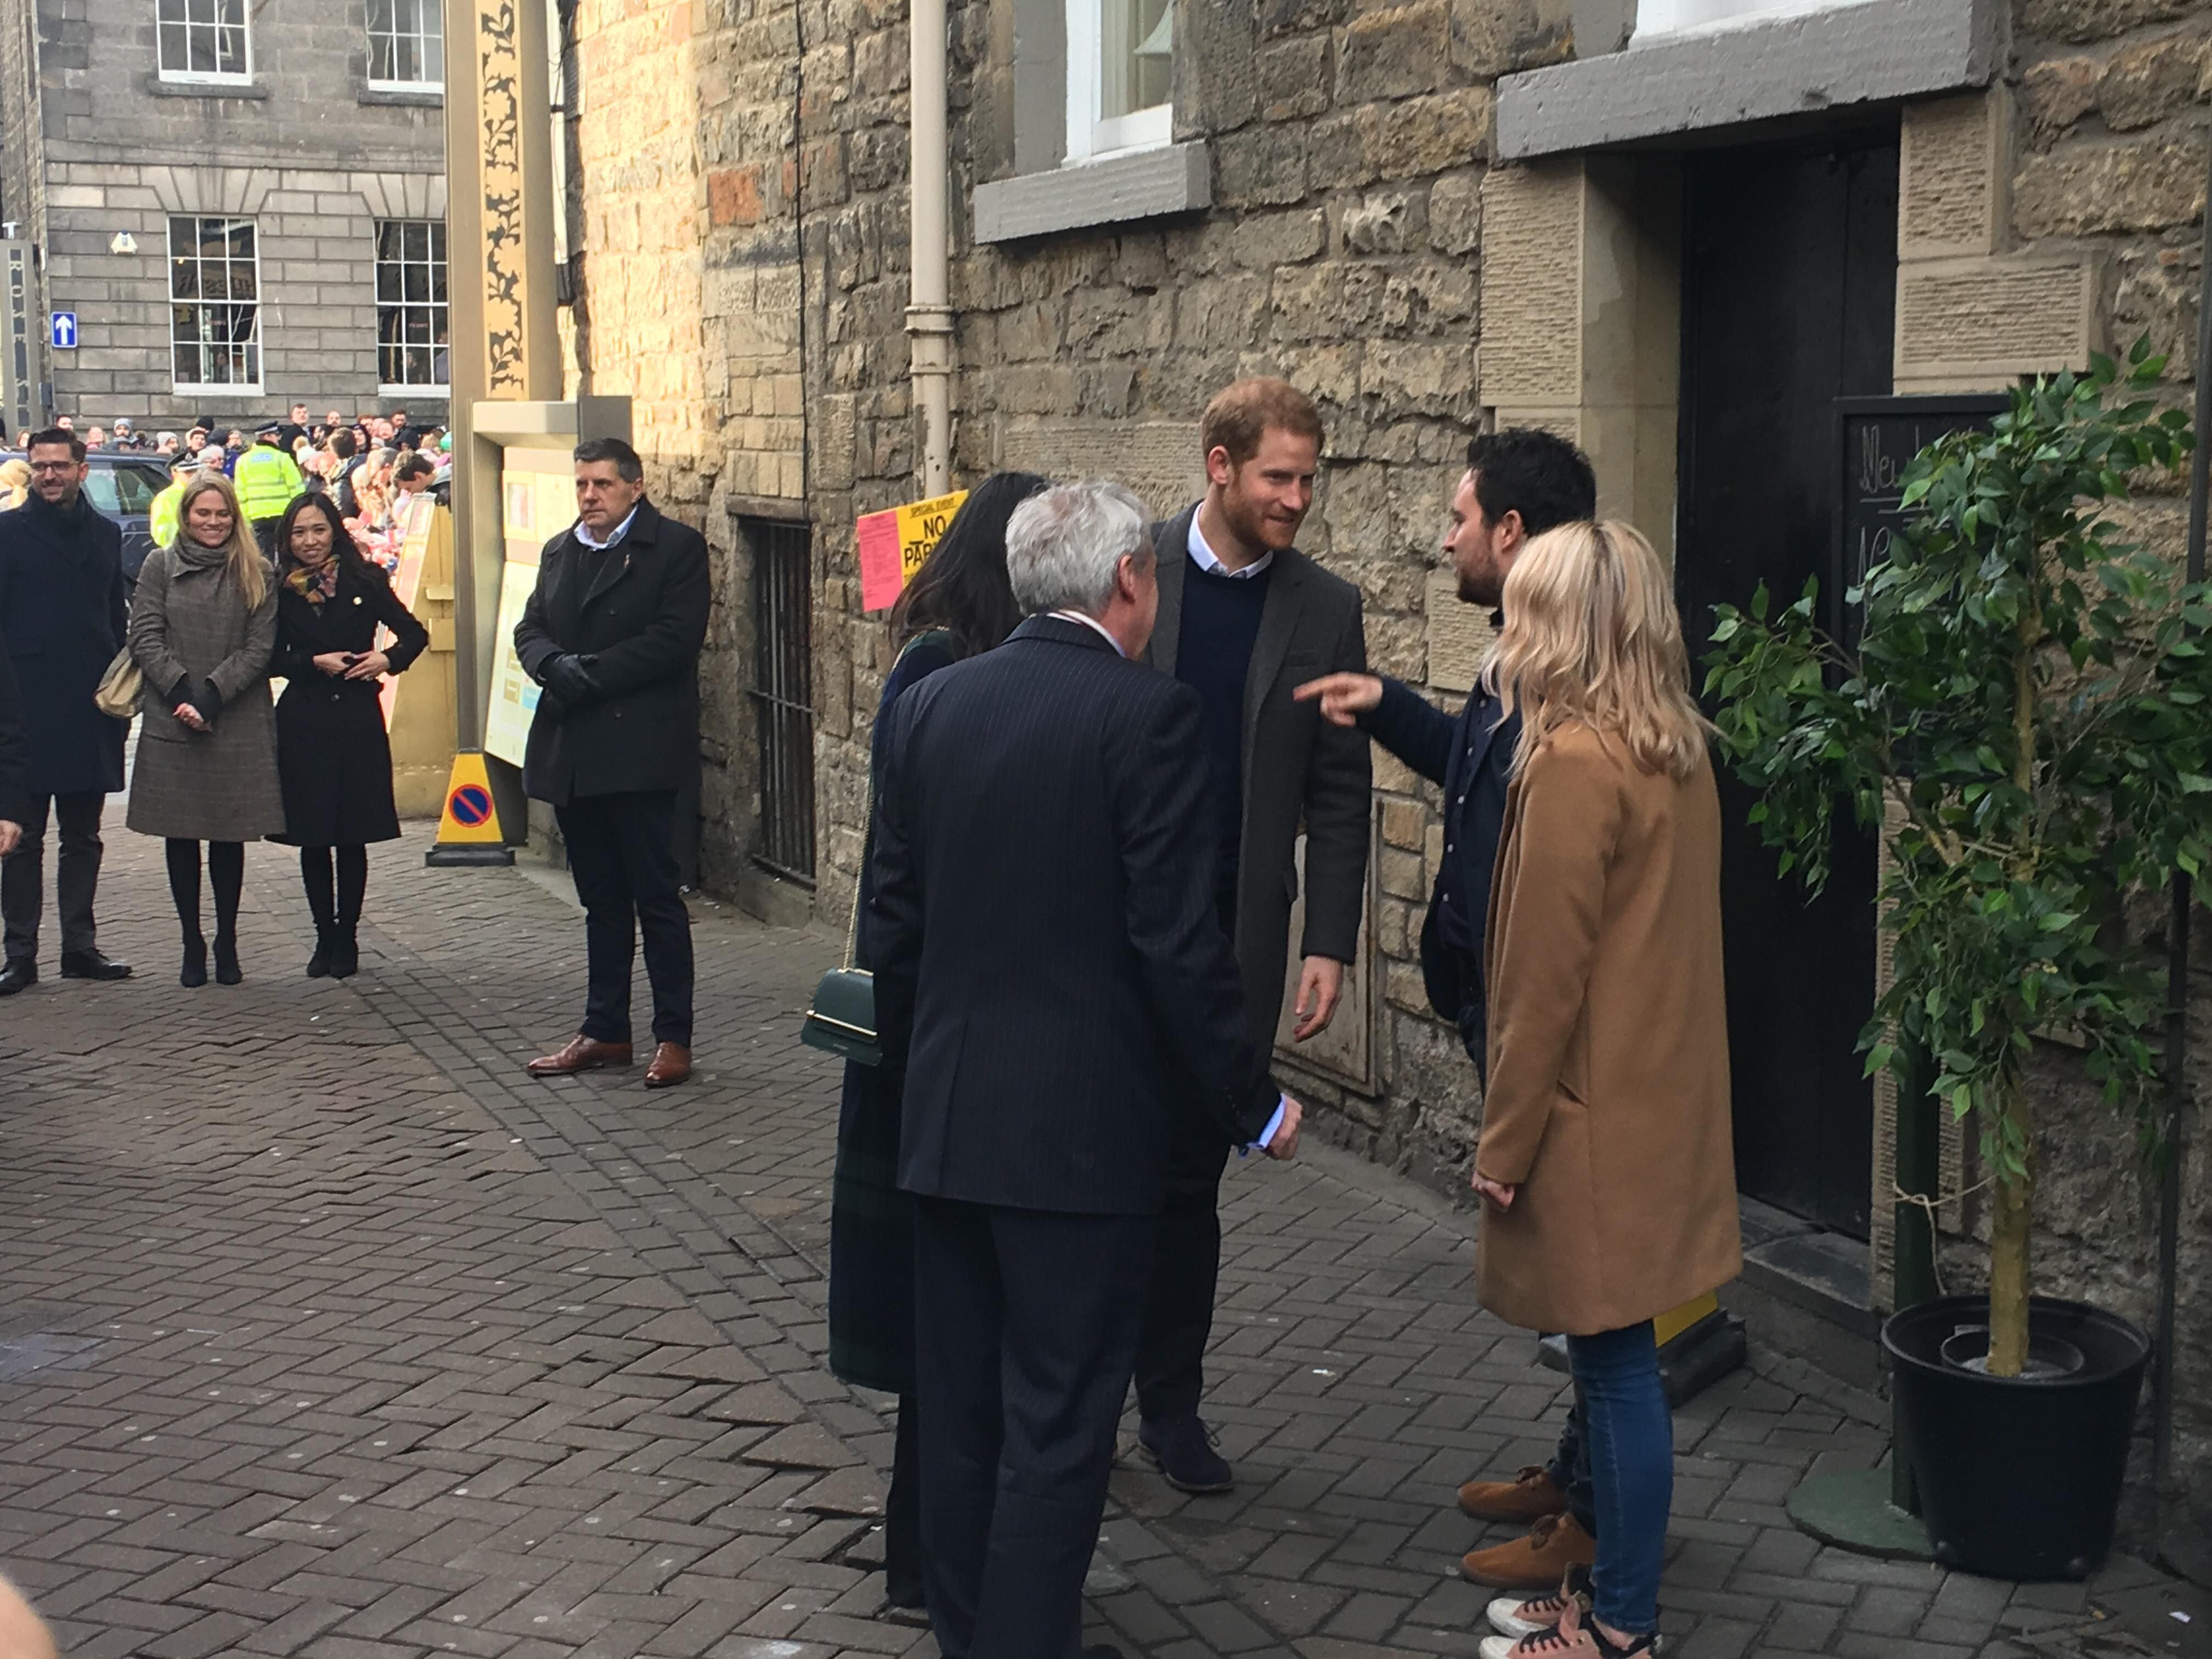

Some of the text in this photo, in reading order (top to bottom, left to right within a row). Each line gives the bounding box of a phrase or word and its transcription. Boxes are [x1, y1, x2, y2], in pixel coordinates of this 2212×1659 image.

[9, 261, 27, 345] ROSE
[923, 515, 946, 539] NO
[904, 541, 937, 568] PAR
